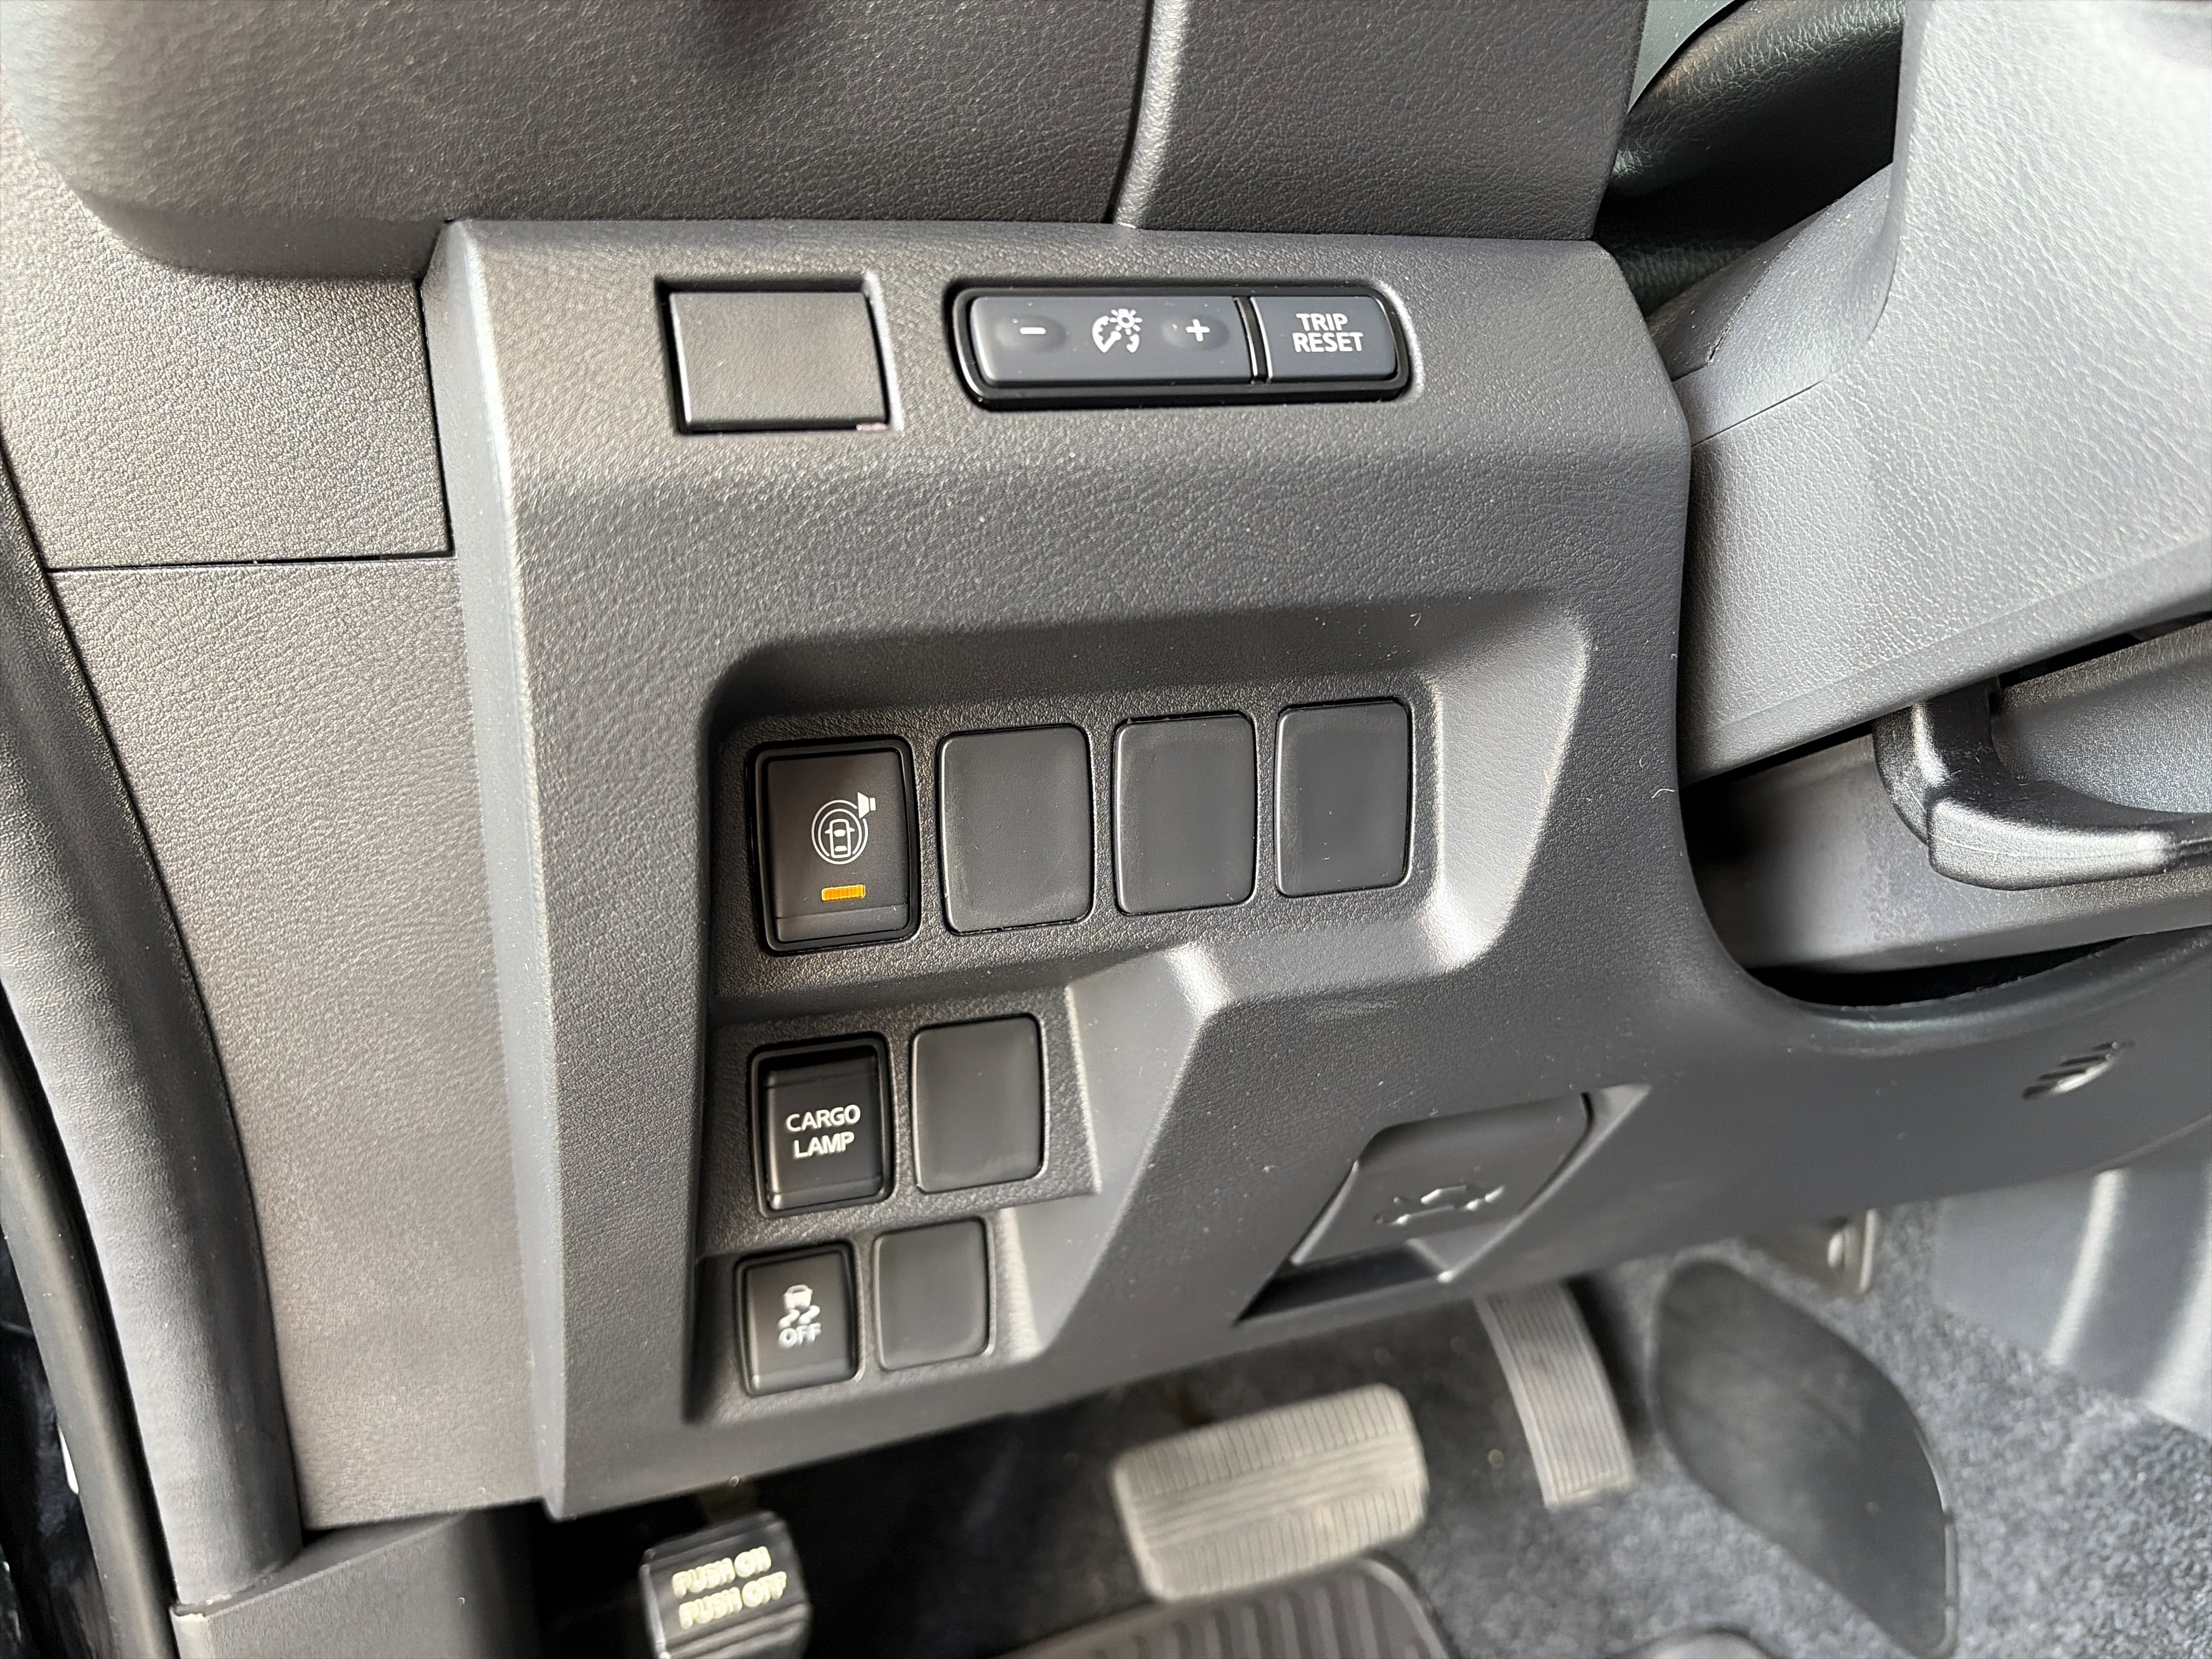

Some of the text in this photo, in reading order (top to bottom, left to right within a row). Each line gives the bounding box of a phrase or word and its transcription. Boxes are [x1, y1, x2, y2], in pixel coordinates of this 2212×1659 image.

[1295, 313, 1348, 331] TRIP
[1292, 331, 1364, 353] RESET
[785, 1104, 861, 1132] CARGO
[793, 1131, 855, 1159] LAMP
[778, 1322, 822, 1349] OFF
[672, 1545, 772, 1599] PUSH ON
[678, 1571, 787, 1630] PUSH OFF
